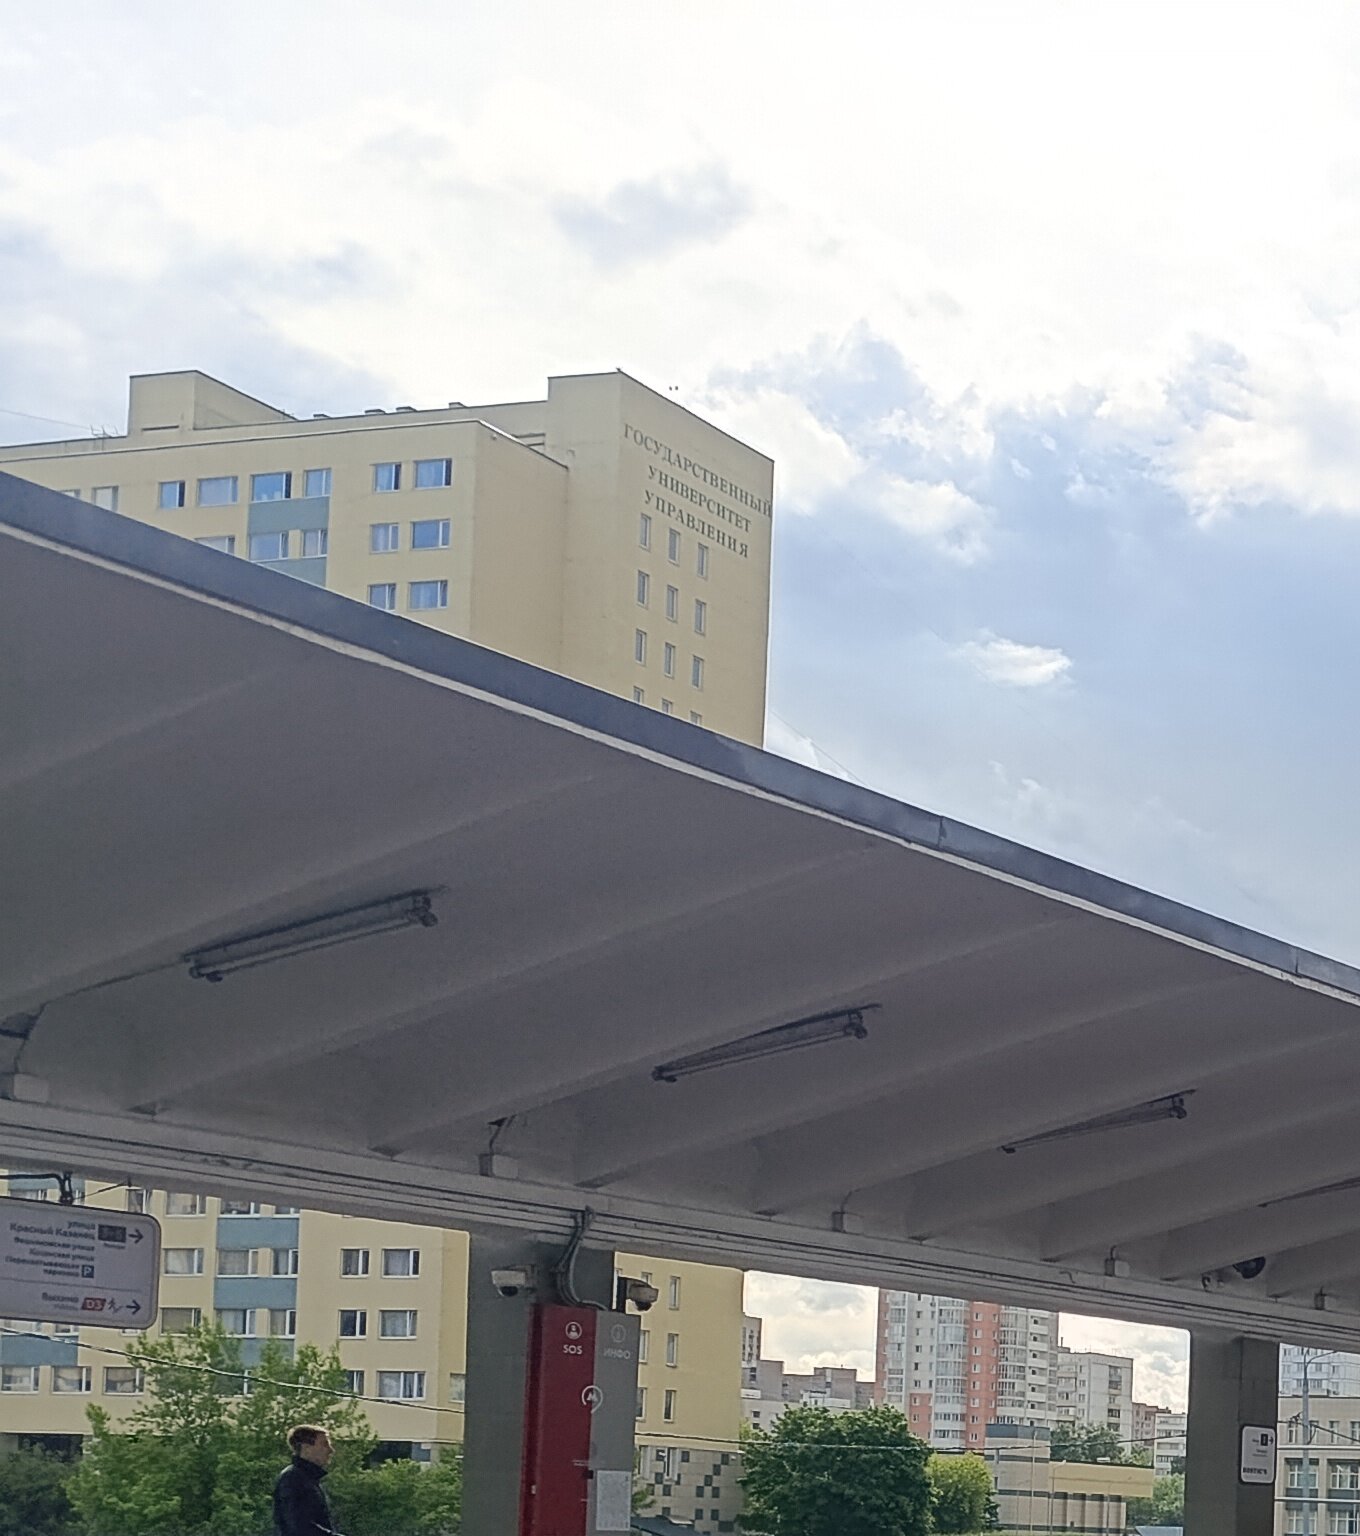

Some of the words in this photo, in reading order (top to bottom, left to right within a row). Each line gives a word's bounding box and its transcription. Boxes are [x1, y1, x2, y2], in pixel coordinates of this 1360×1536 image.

[623, 423, 773, 519] ГОСУДАРСТВЕННЫЙ
[648, 464, 752, 534] УНИВЕРСИТЕТ
[644, 489, 749, 559] УПРАВЛЕНИЯ
[563, 1344, 583, 1355] SOS
